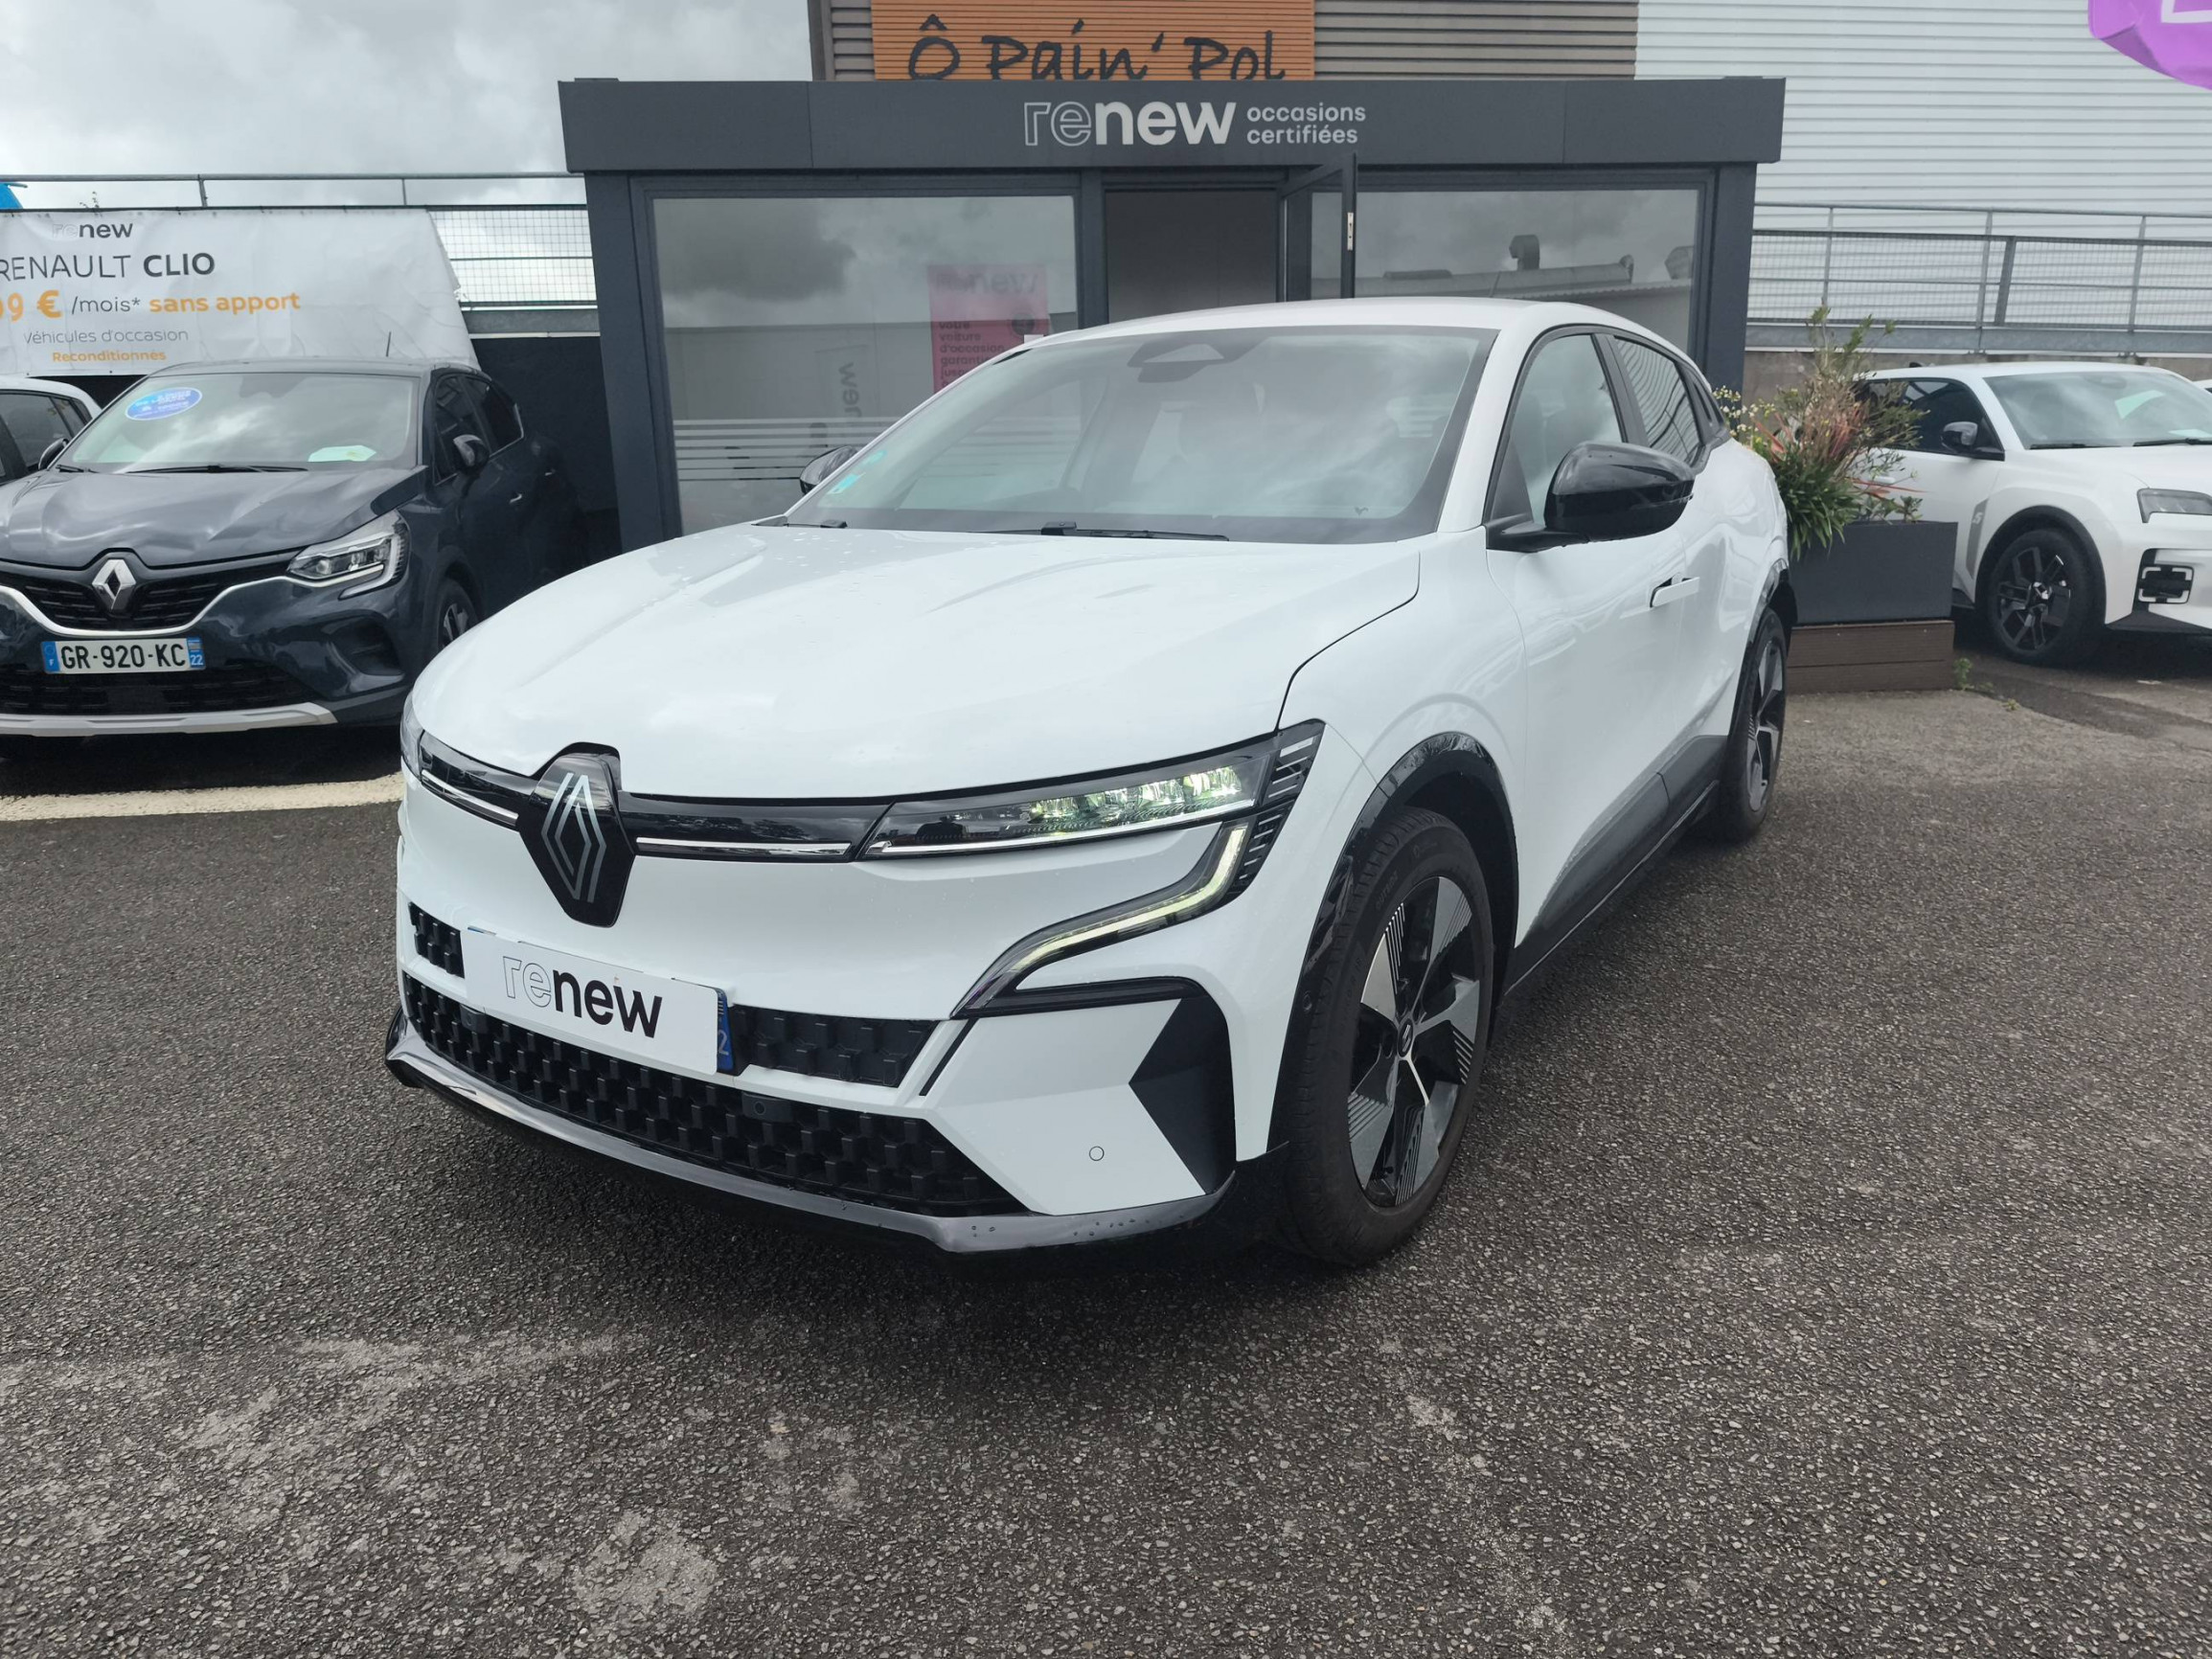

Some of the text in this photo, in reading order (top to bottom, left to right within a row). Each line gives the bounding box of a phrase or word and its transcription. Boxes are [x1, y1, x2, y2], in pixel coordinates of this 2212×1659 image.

[908, 13, 959, 80] Ô
[1184, 30, 1285, 80] Pol
[1246, 103, 1366, 122] occasions
[1024, 101, 1237, 147] renew
[1246, 124, 1358, 144] certifiées
[52, 222, 134, 239] renew
[0, 252, 216, 282] RENAULT CLIO
[36, 289, 62, 319] €
[148, 298, 210, 313] sans
[216, 292, 301, 315] apport
[23, 329, 190, 344] Véhicules d'occasion
[52, 350, 167, 363] Reconditionnés
[940, 344, 1004, 353] d'occasion
[60, 643, 186, 670] GR-920-KC
[191, 654, 204, 666] 22
[503, 956, 663, 1038] renew
